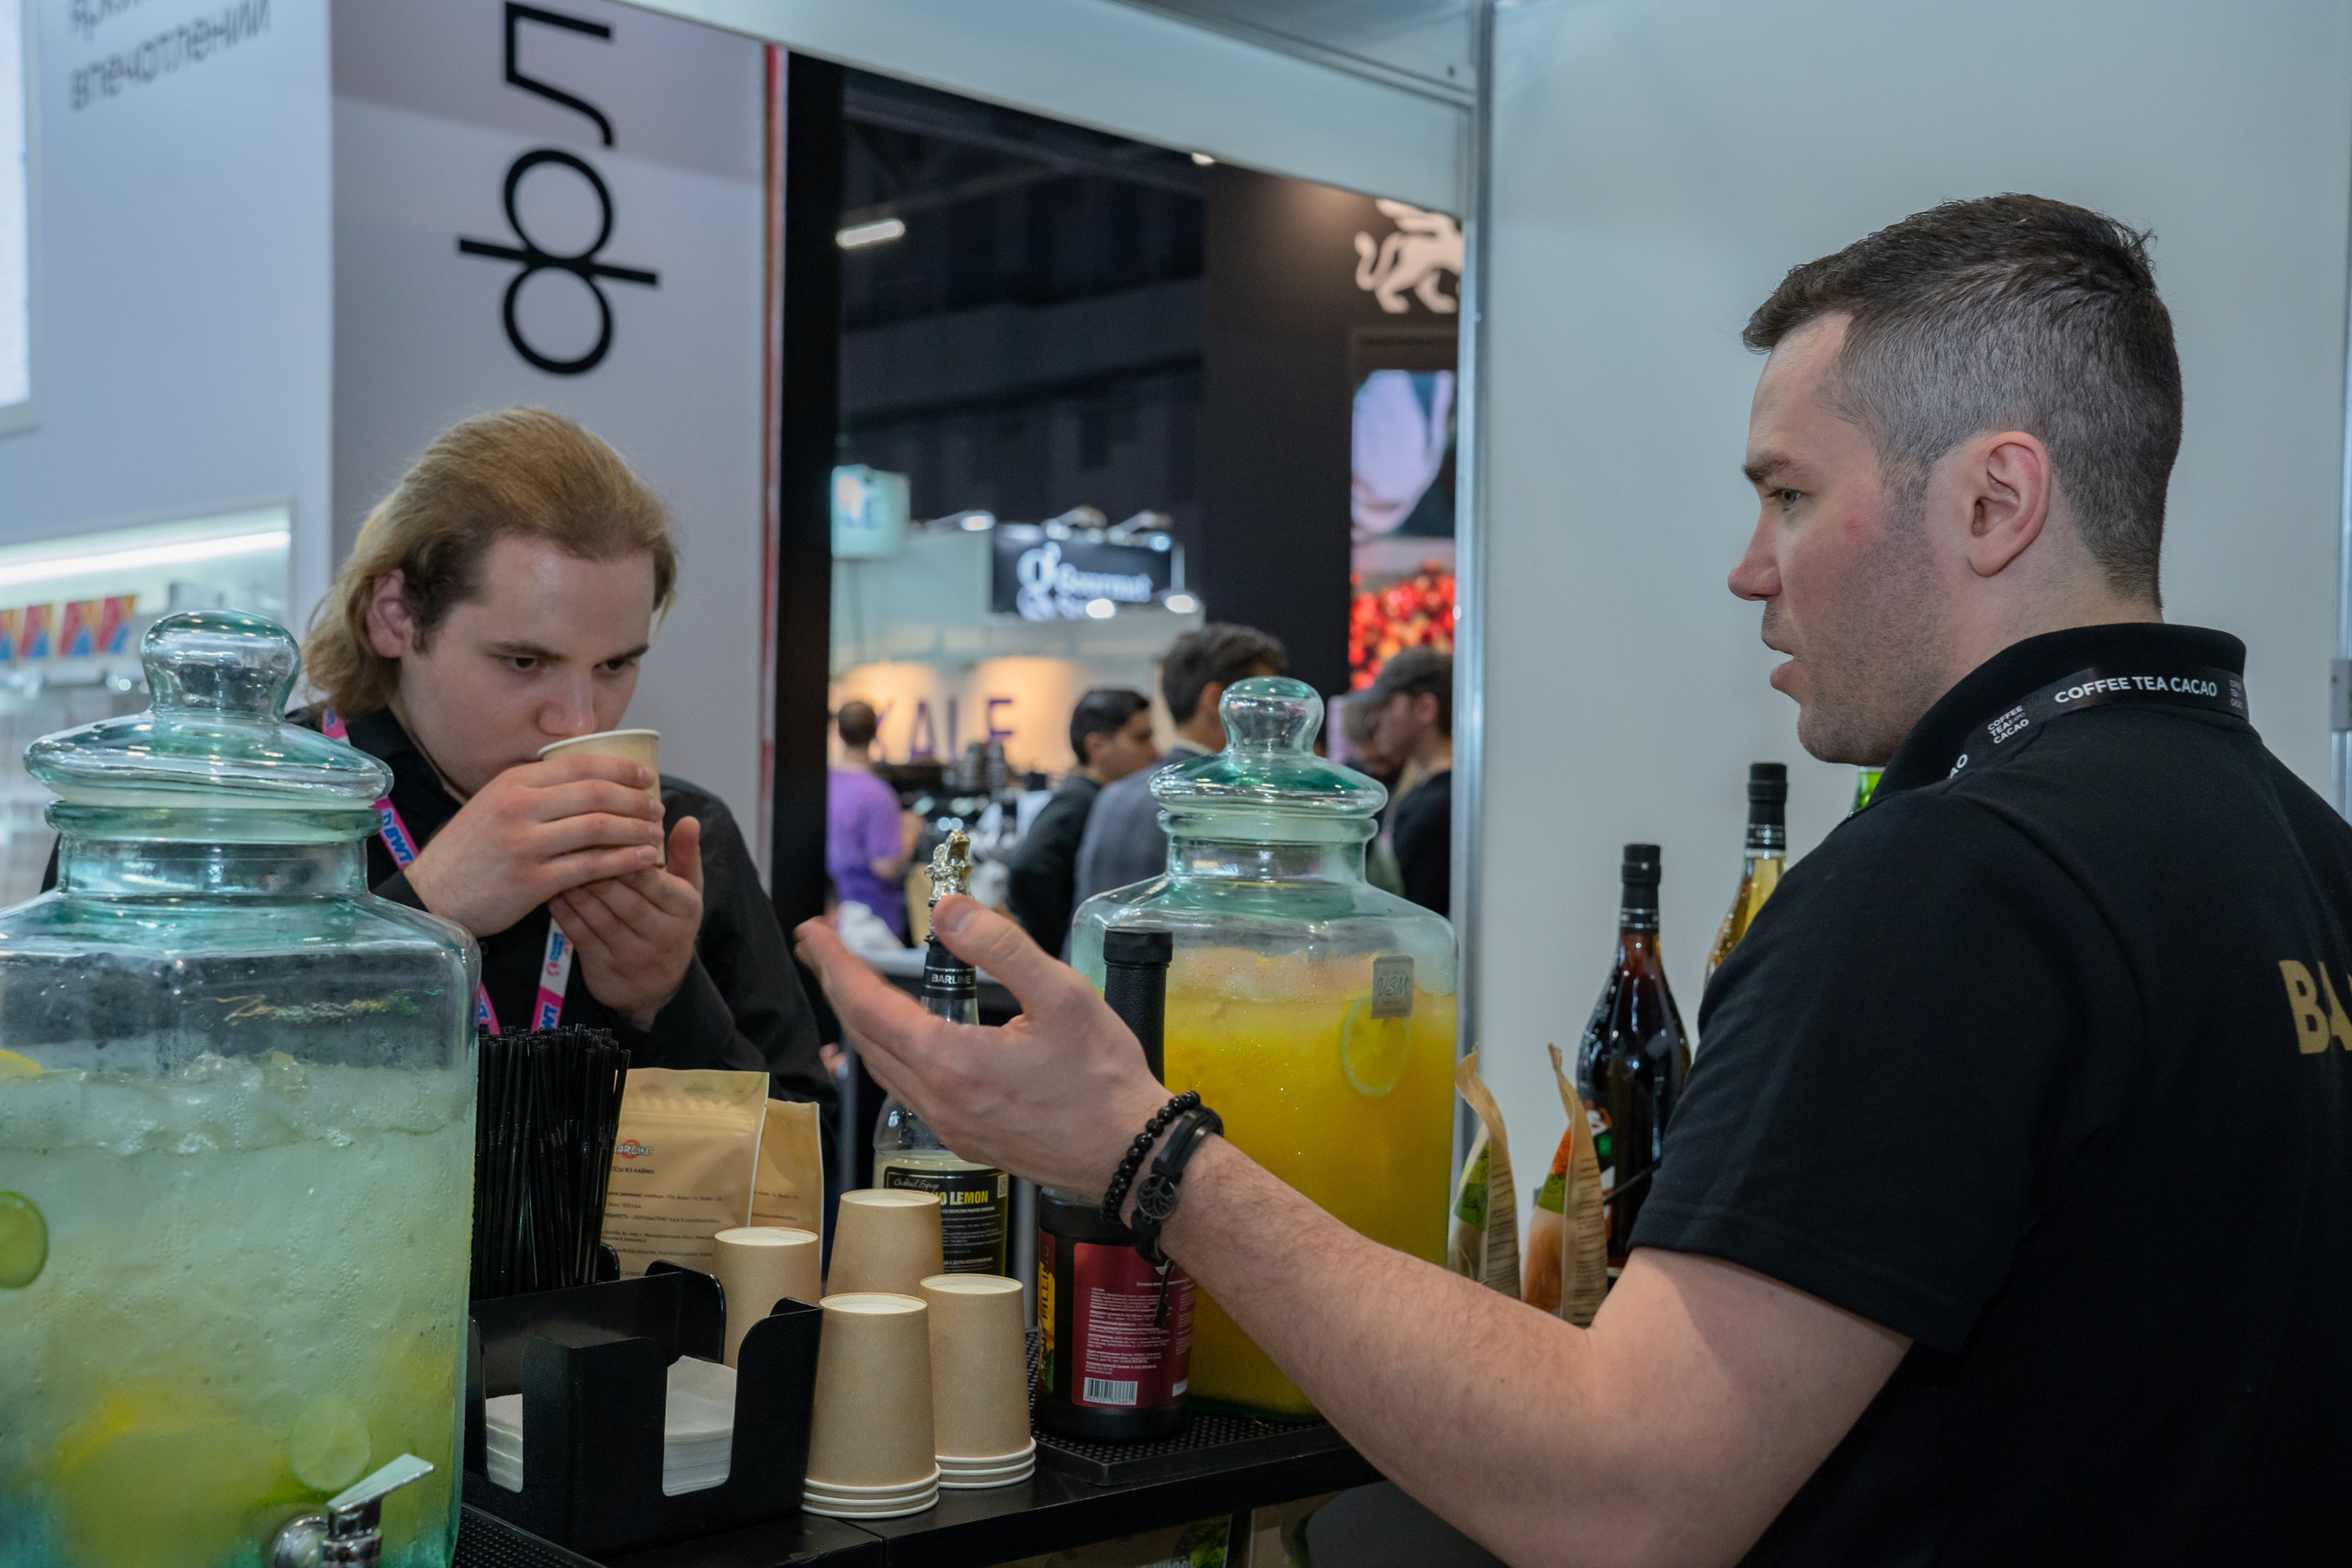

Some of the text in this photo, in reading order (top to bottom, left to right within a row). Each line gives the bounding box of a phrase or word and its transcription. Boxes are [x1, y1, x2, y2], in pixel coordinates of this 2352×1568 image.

[2054, 676, 2218, 704] COFFEE TEA CACAO
[1987, 705, 2023, 731] COFFEE
[1990, 721, 2010, 738] TEA
[1993, 718, 2030, 745] CACAO
[384, 826, 413, 863] BWT
[932, 974, 971, 985] BARLINE
[2278, 959, 2352, 1055] BA
[949, 1190, 989, 1205] LEMON
